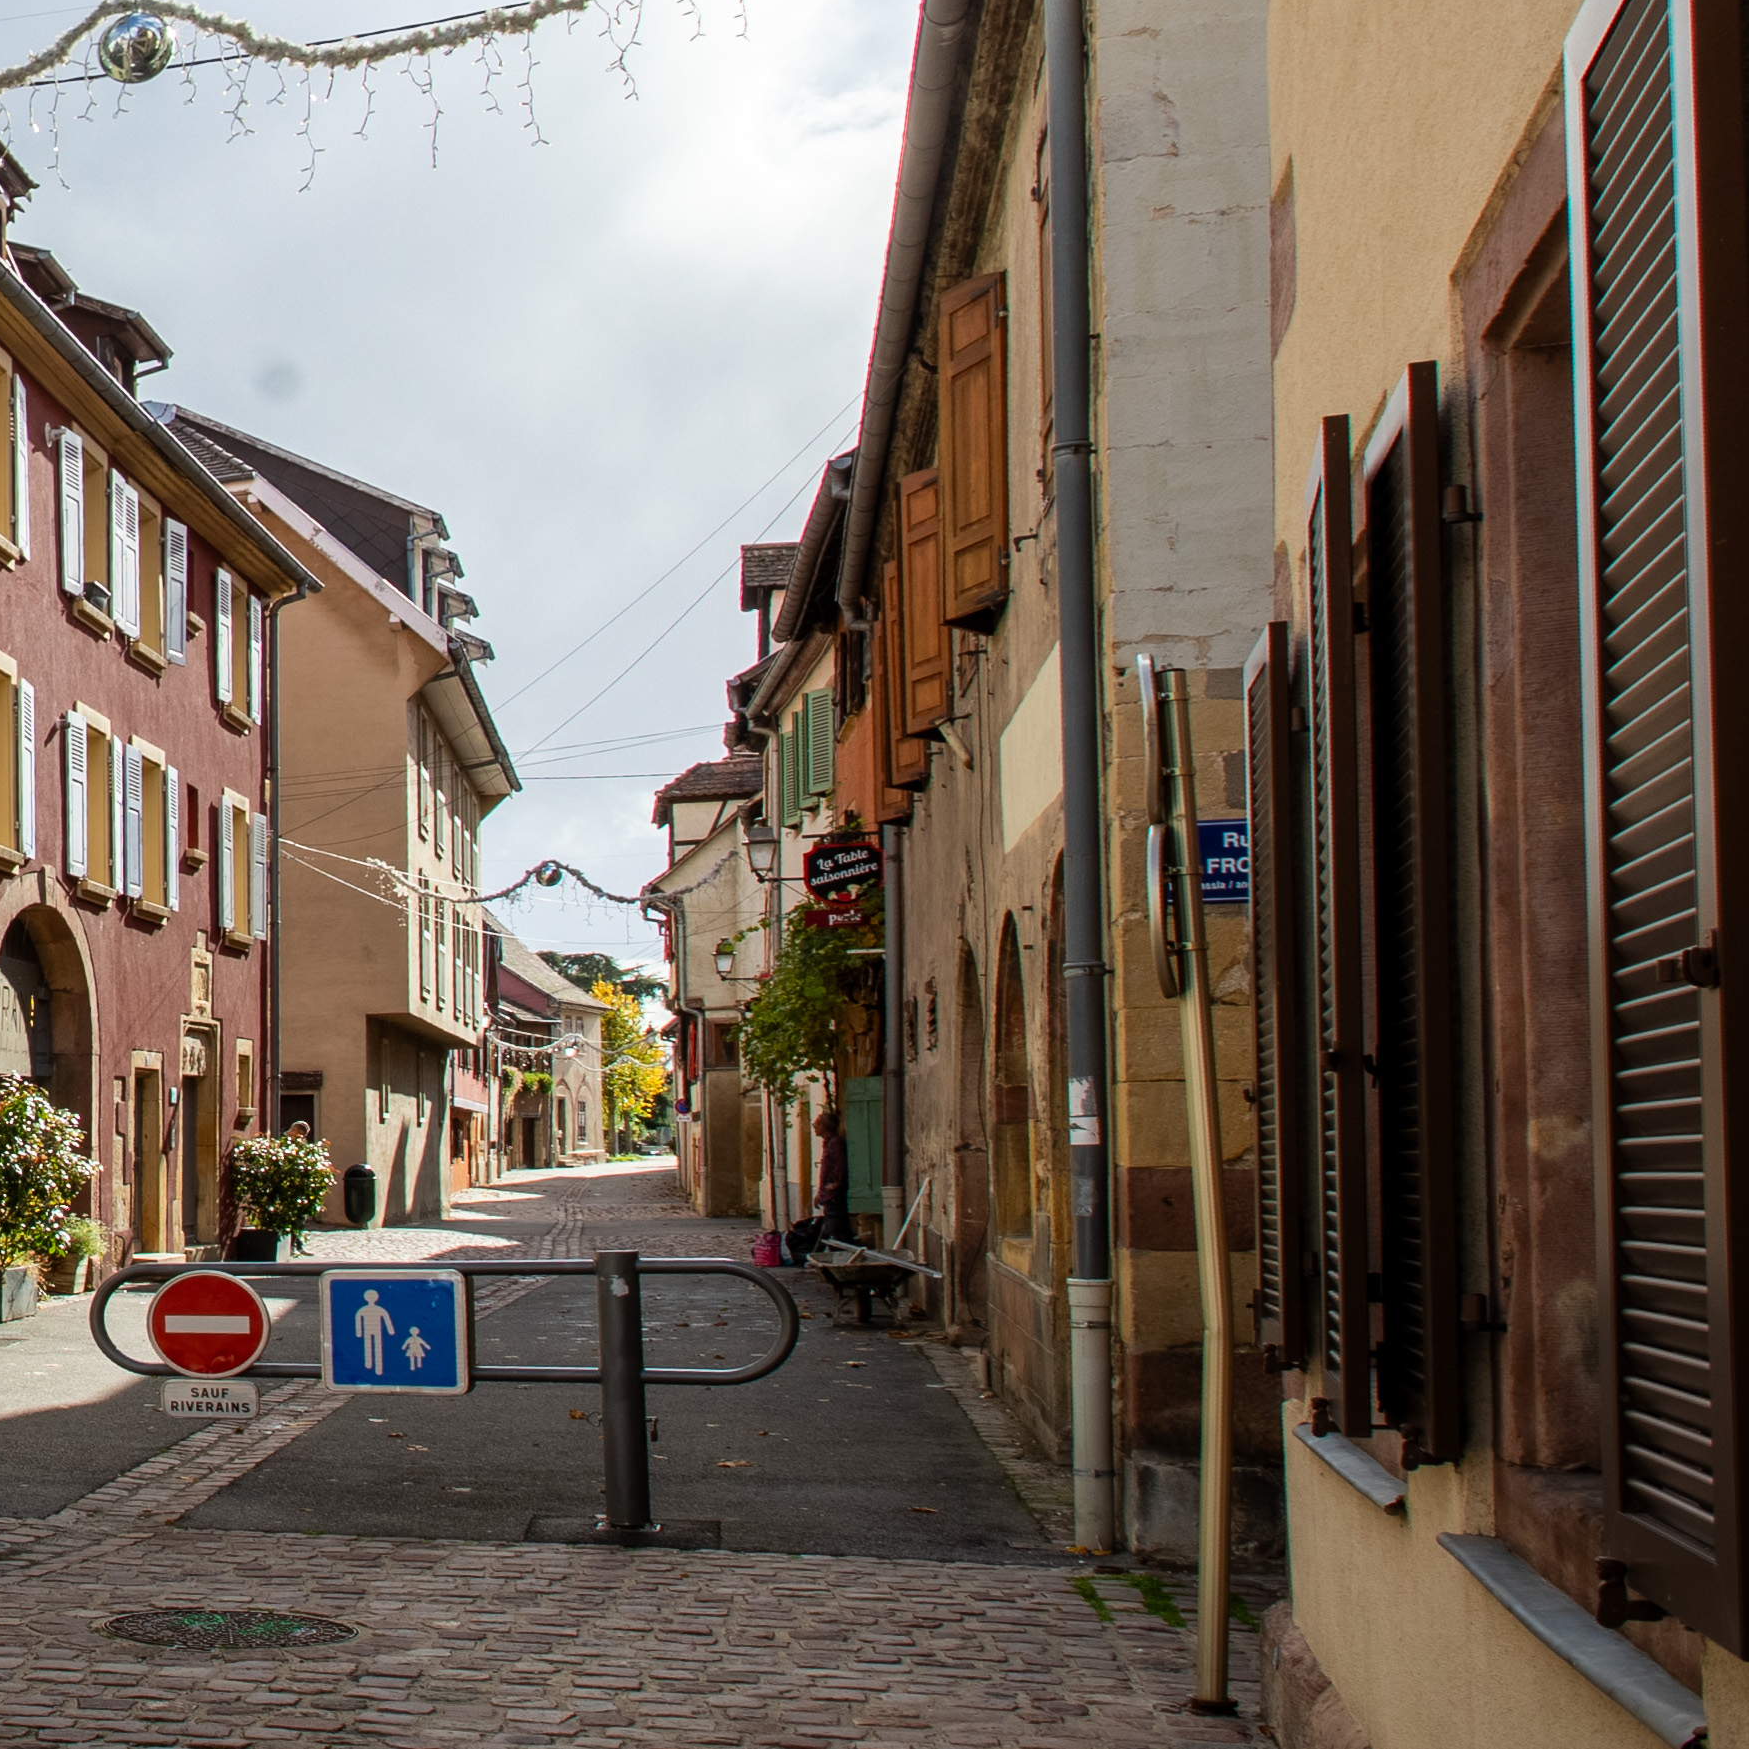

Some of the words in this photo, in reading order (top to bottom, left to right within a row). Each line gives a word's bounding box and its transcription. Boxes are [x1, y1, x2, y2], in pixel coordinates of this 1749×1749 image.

[816, 858, 834, 871] La
[834, 849, 870, 865] Table
[810, 862, 879, 886] saisonnière
[190, 1387, 229, 1399] SAUF
[170, 1400, 251, 1413] RIVERAINS
